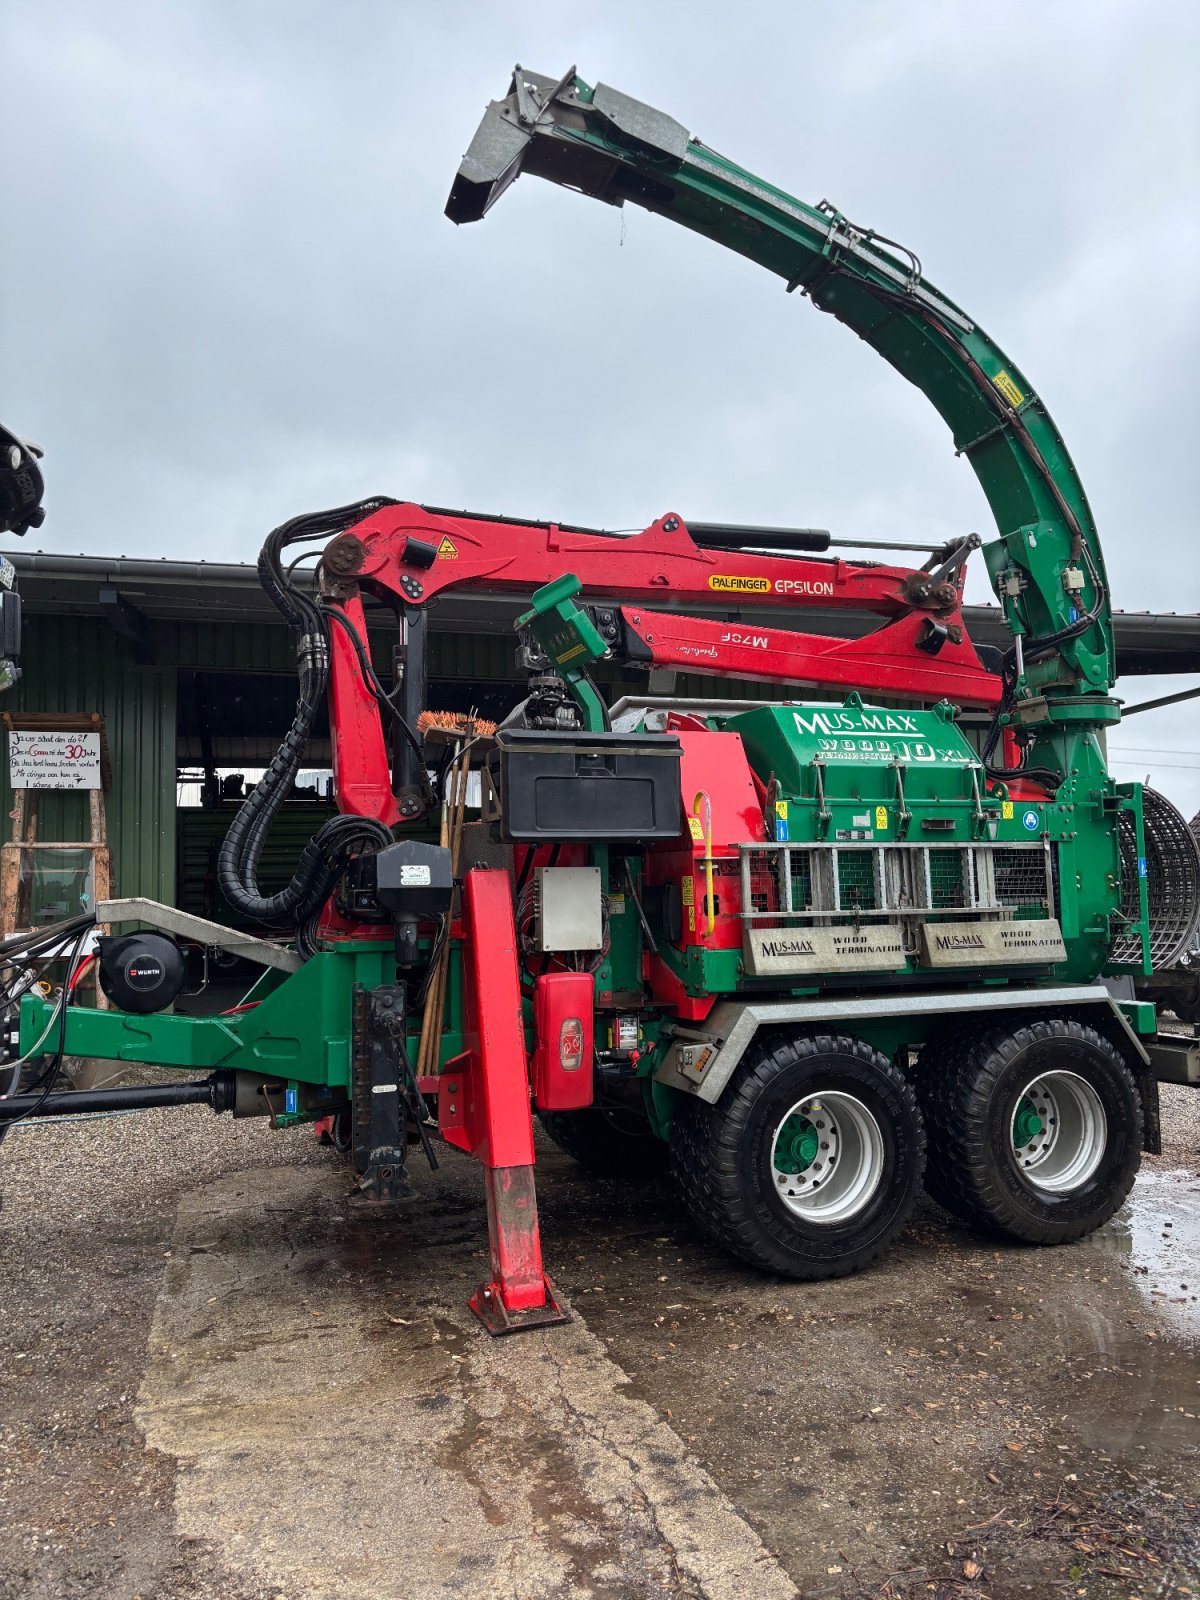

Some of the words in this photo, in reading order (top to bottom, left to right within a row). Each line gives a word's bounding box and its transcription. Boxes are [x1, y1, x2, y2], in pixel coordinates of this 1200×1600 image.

[712, 577, 767, 590] PALFINGER
[774, 579, 834, 595] EPSILON
[792, 712, 917, 735] MUS-MAX
[65, 744, 83, 759] 30
[817, 738, 891, 752] WOOD
[893, 741, 936, 762] 10
[936, 748, 971, 762] XL
[833, 936, 867, 944] WOOD
[936, 934, 983, 951] MUS-MAX
[1003, 938, 1063, 948] TERMINATOR
[1000, 930, 1031, 939] WOOD
[761, 940, 814, 957] MUS-MAX
[835, 945, 902, 955] TERMINATOR
